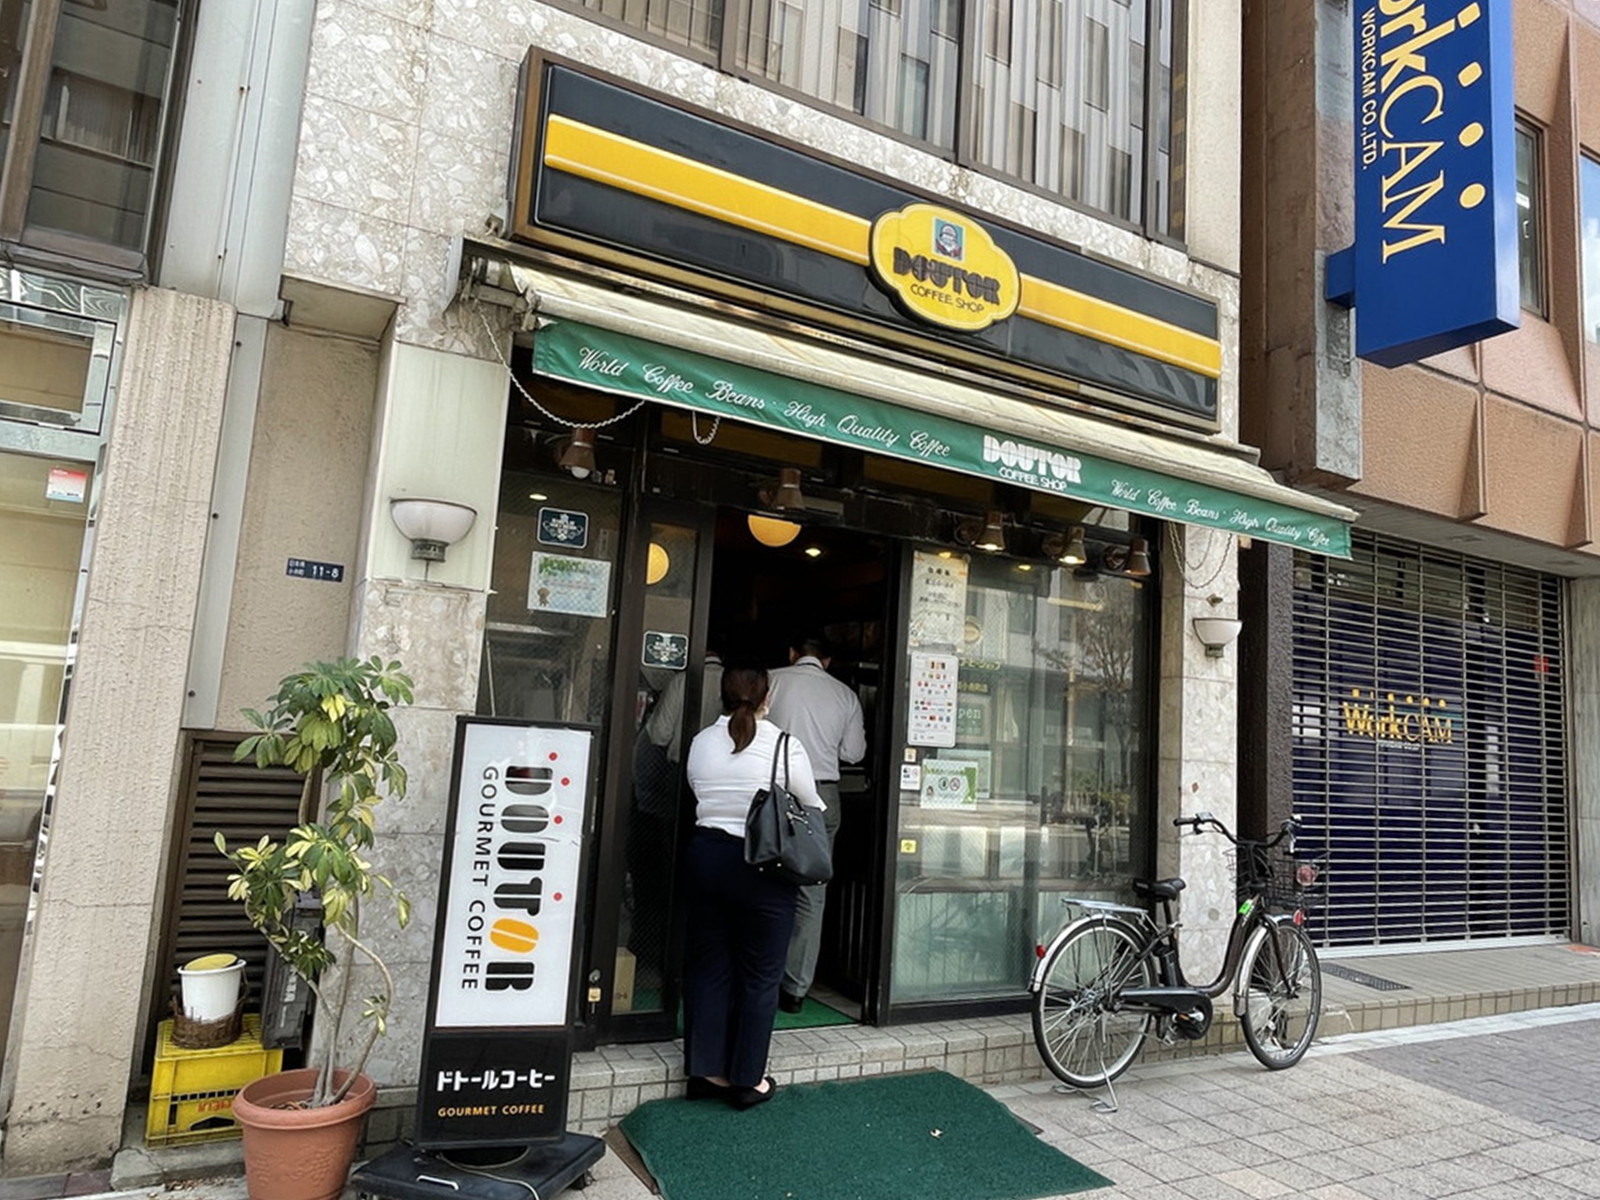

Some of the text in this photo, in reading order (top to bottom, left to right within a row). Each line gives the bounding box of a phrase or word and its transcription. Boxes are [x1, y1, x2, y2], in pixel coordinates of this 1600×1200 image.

[1361, 7, 1378, 170] WORKCAM CO.,LTD.
[893, 247, 1000, 306] DOUTOR
[910, 284, 984, 313] COFFEE SHOP
[579, 347, 950, 458] World Coffee Beans High Quality Coffee
[983, 435, 1082, 484] DOUTOR
[999, 467, 1067, 491] COFFEE SHOP
[1111, 479, 1141, 501] World
[1147, 488, 1177, 512] Coffee
[1184, 498, 1219, 520] Beans
[1229, 509, 1259, 530] High
[1265, 517, 1301, 540] Quality
[1343, 701, 1453, 744] WorkCAM
[461, 766, 499, 989] GOURMET COFFEE
[484, 766, 553, 991] DOUTOR
[437, 1069, 555, 1091] ドトールコーヒー
[438, 1104, 544, 1117] GOURMET COFFEE
